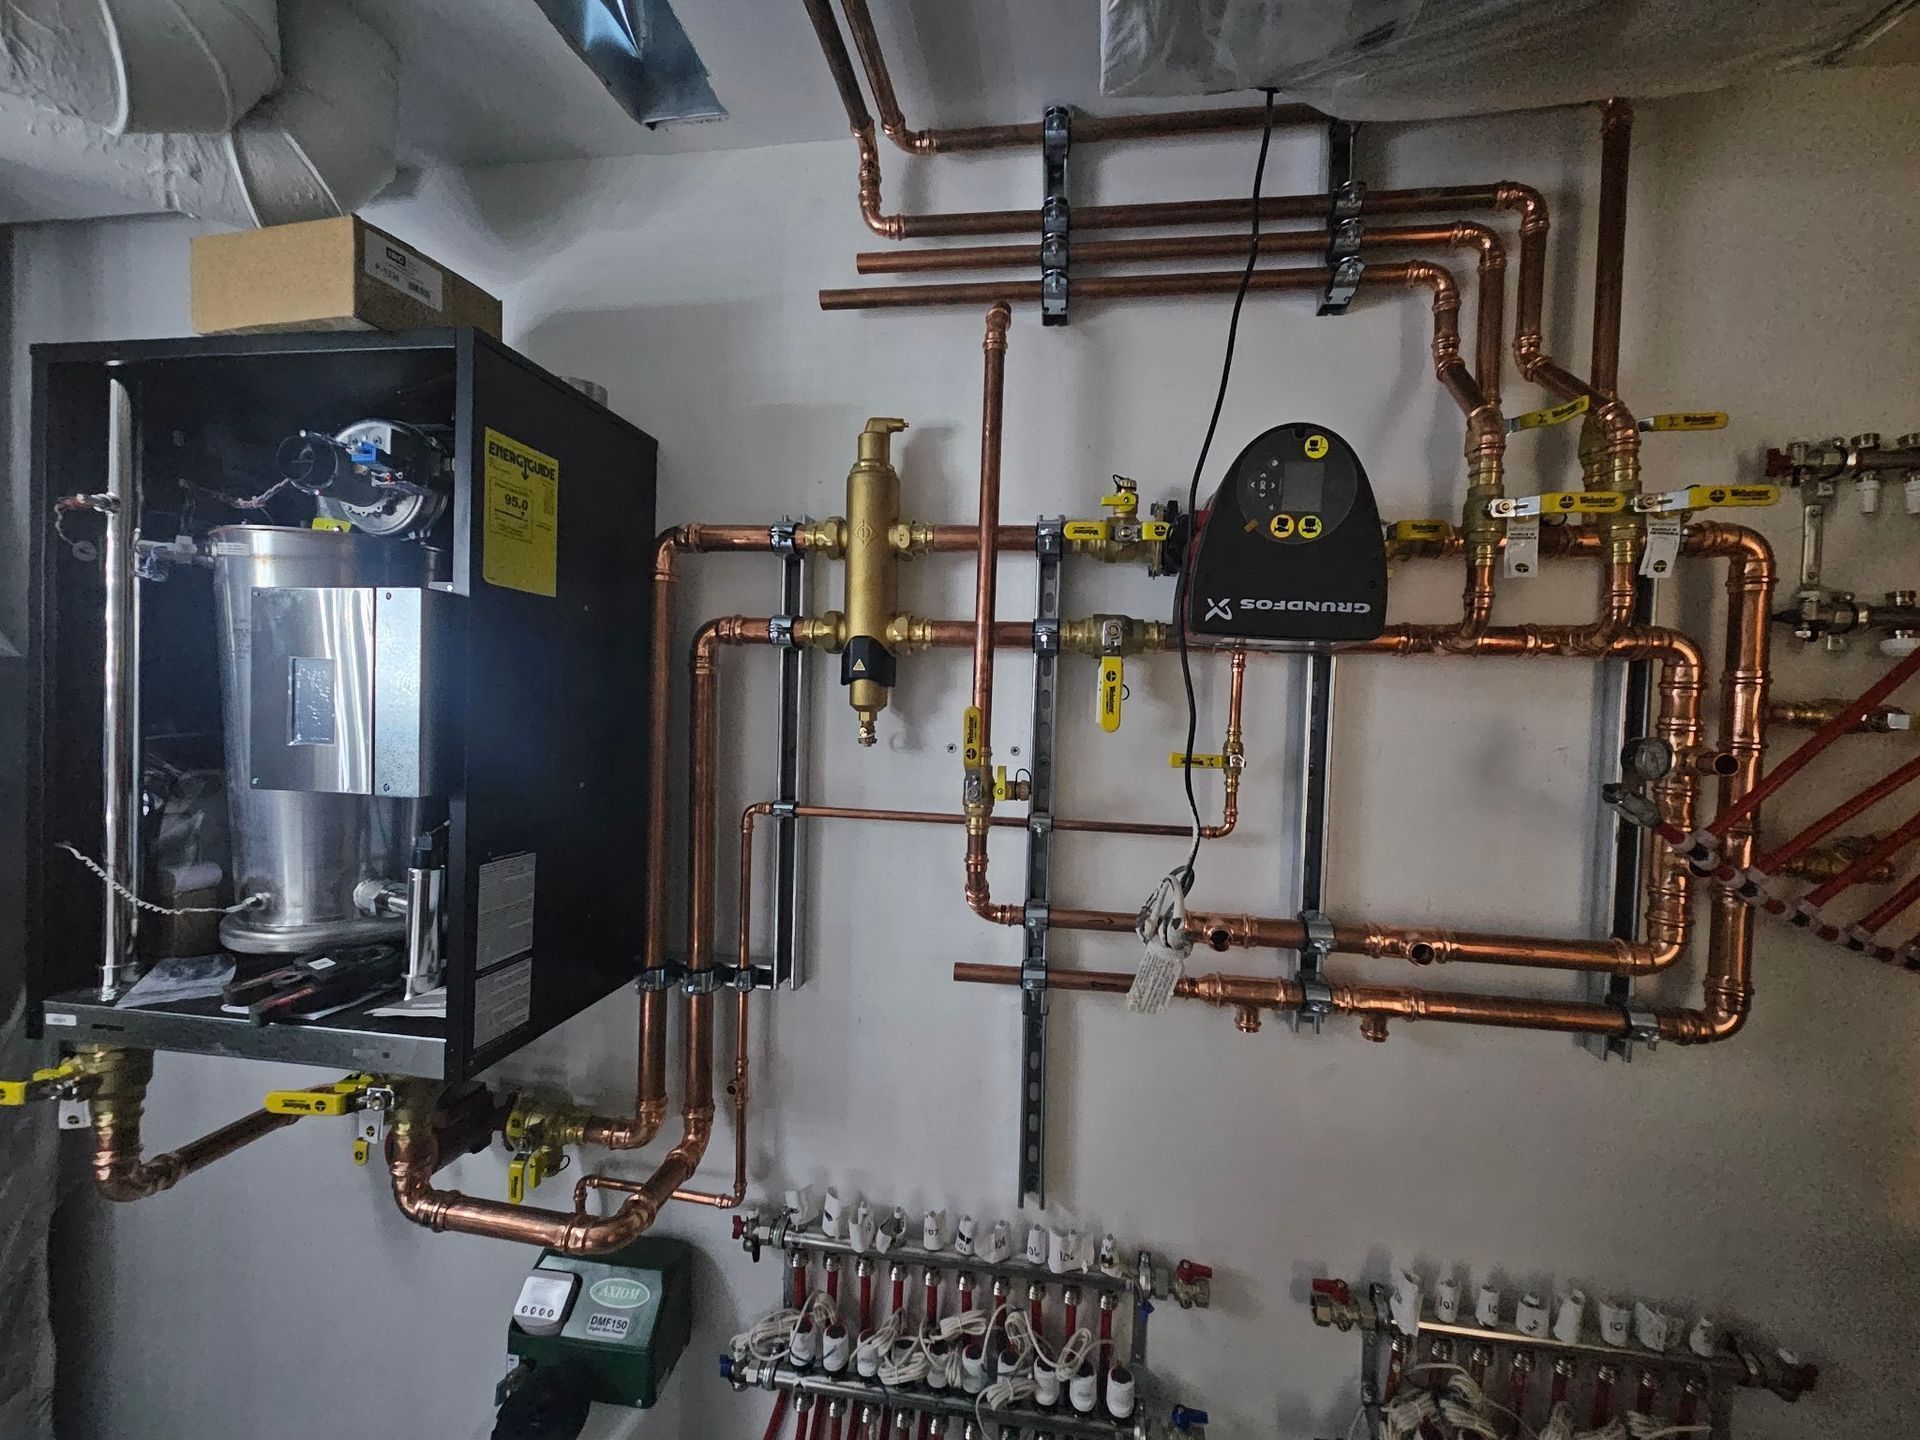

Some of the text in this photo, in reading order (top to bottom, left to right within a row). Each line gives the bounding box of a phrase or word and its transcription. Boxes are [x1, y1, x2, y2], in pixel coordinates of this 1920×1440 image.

[1580, 496, 1618, 504] Webstone
[1730, 489, 1770, 497] Webstone
[504, 493, 529, 512] 95.0
[1240, 598, 1371, 614] GRUNDFOS
[599, 1285, 640, 1300] AXIOM
[590, 1316, 628, 1330] DMF150
